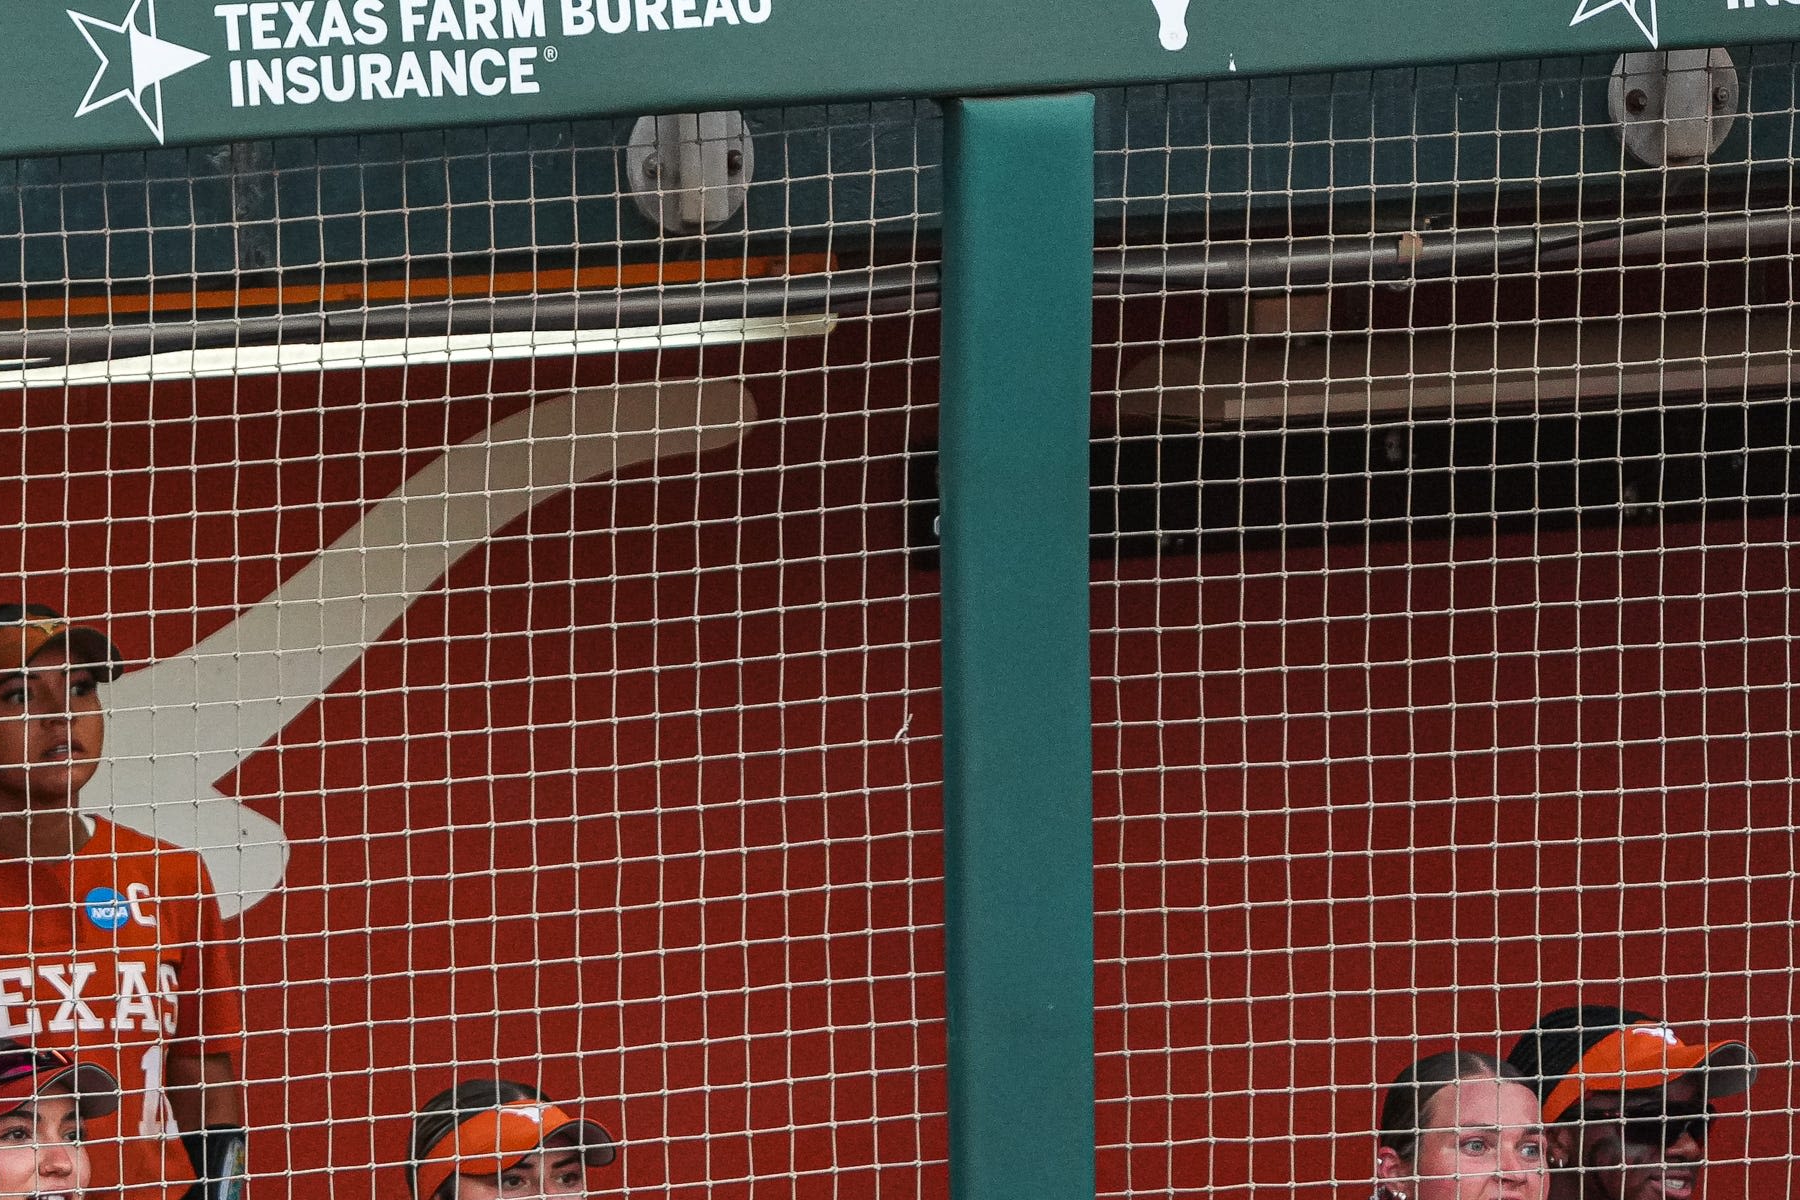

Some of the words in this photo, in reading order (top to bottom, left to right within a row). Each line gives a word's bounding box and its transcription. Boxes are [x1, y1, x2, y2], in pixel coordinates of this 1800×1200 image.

[214, 0, 388, 51] TEXAS
[401, 0, 546, 43] FARM
[561, 0, 773, 36] BUREAU
[91, 906, 129, 920] NCAA
[126, 882, 157, 928] C
